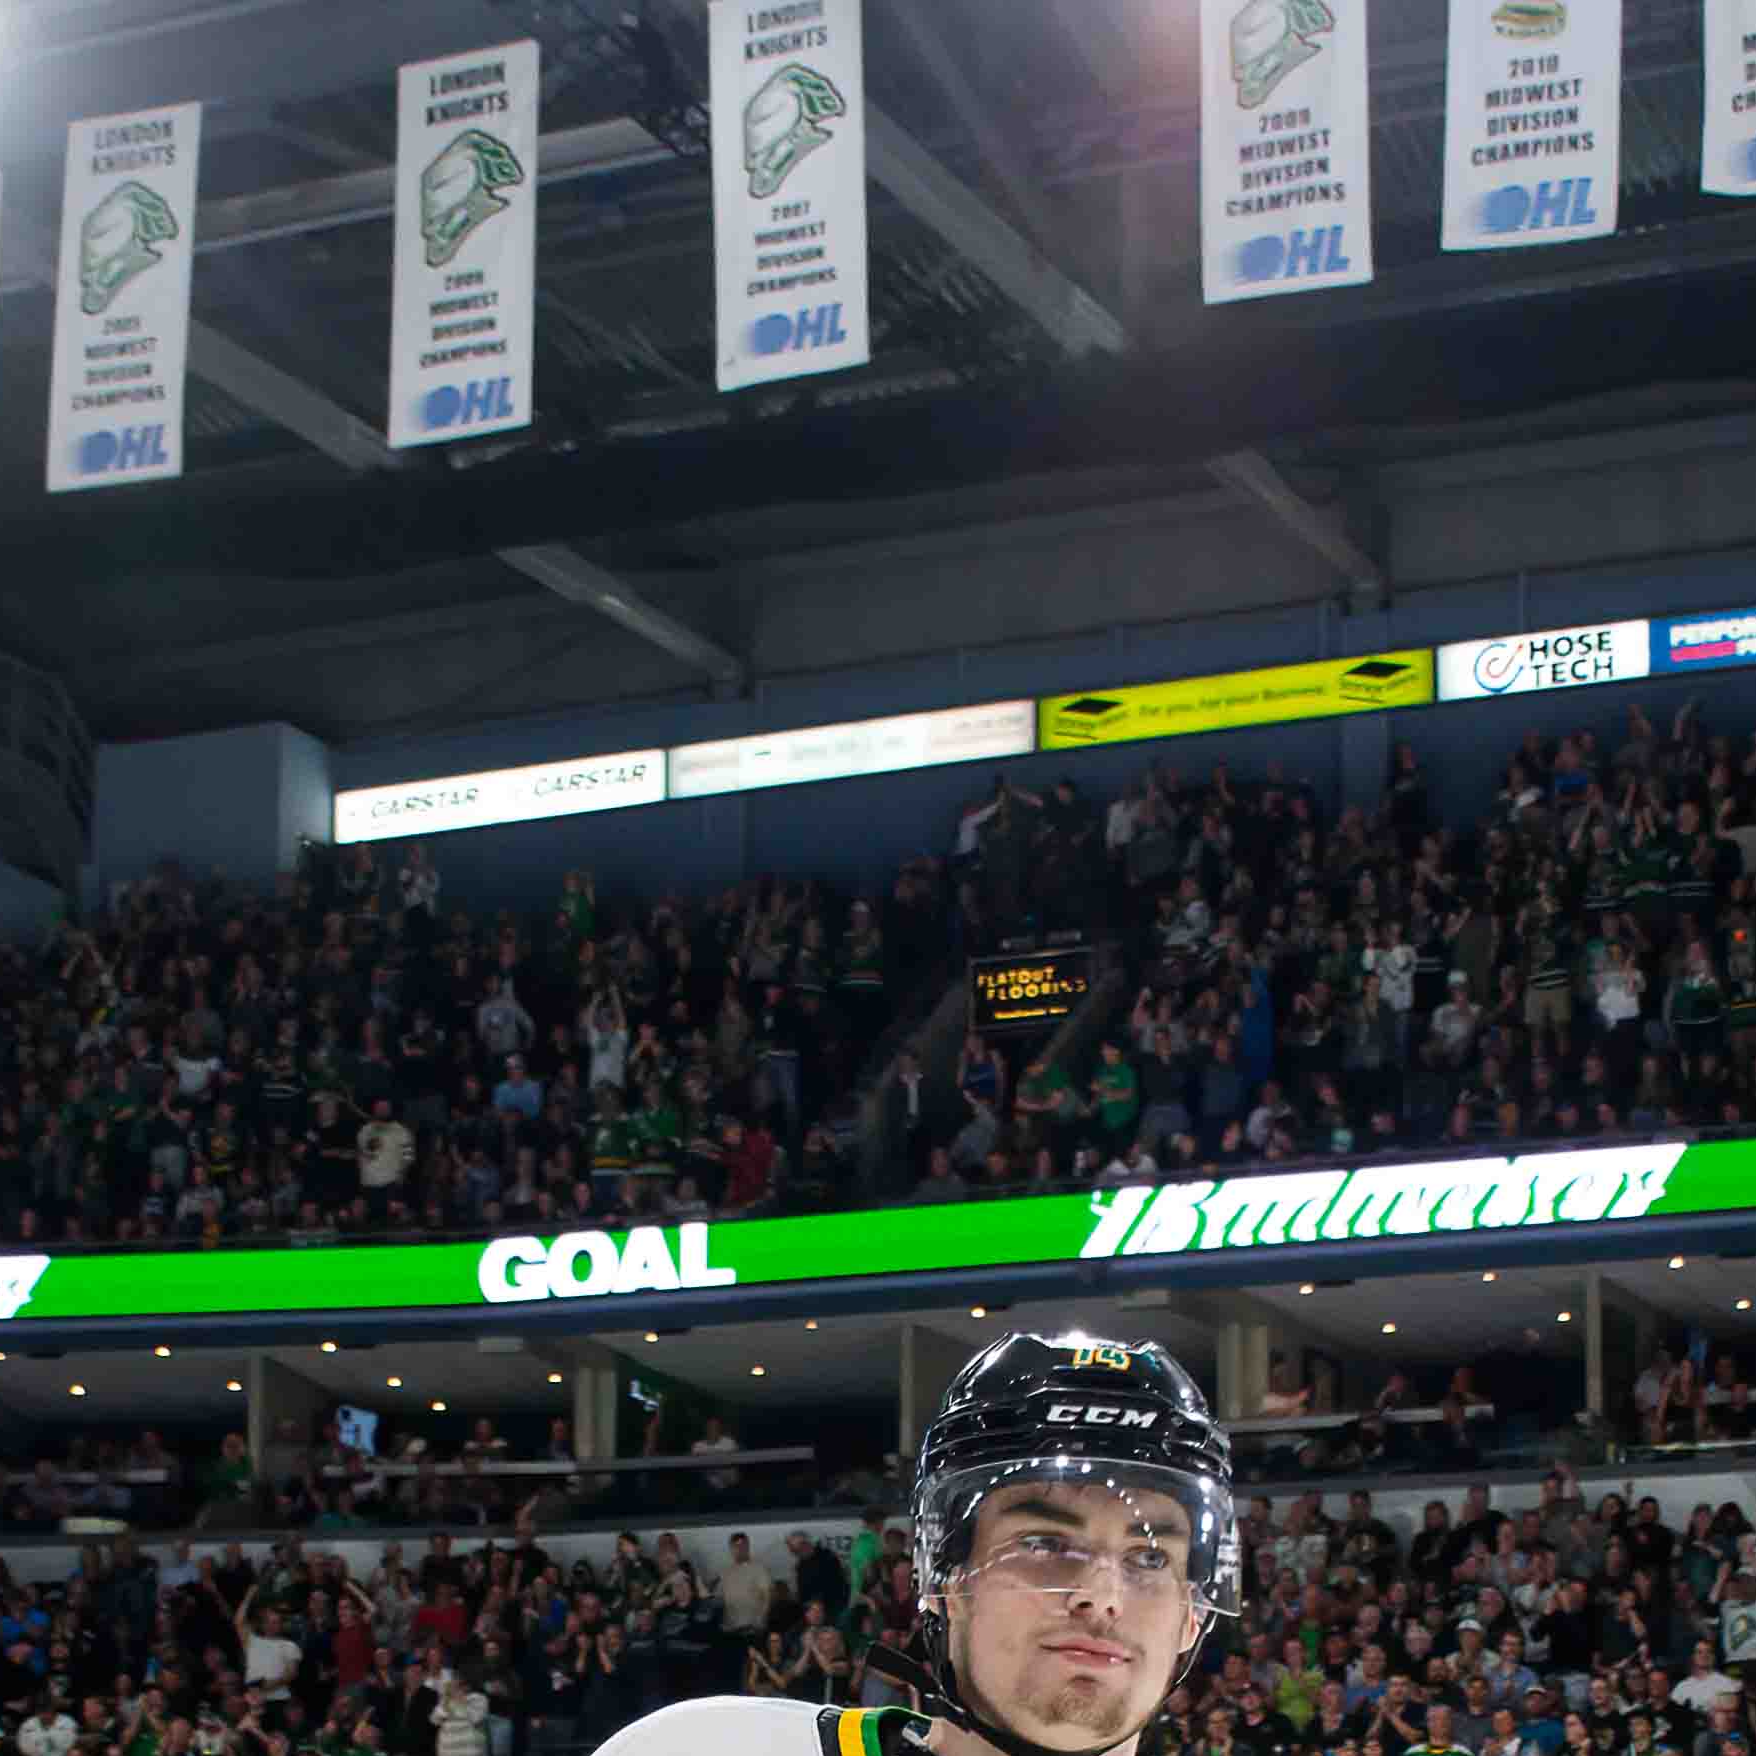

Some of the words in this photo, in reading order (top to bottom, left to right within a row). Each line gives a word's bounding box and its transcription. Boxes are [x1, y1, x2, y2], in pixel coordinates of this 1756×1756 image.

[748, 0, 824, 33] LONDON
[745, 27, 827, 61] KNIGHTS
[1485, 78, 1583, 109] MIDWEST
[95, 121, 173, 149] LONDON
[1487, 107, 1579, 136] DIVISION
[93, 145, 175, 174] KNIGHTS
[1239, 130, 1331, 164] MIDWEST
[1472, 132, 1594, 166] CHAMPIONS
[1242, 157, 1330, 190] DIVISION
[1225, 183, 1346, 217] CHAMPIONS
[1475, 177, 1596, 233] OHL
[1223, 224, 1350, 283] OHL
[745, 303, 846, 355] OHL
[414, 377, 514, 431] OHL
[73, 424, 168, 475] OHL
[1530, 631, 1612, 660] HOSE
[1531, 655, 1613, 688] TECH
[1079, 1143, 1687, 1259] Budweiser
[478, 1222, 736, 1302] GOAL
[1046, 1405, 1157, 1428] CCM
